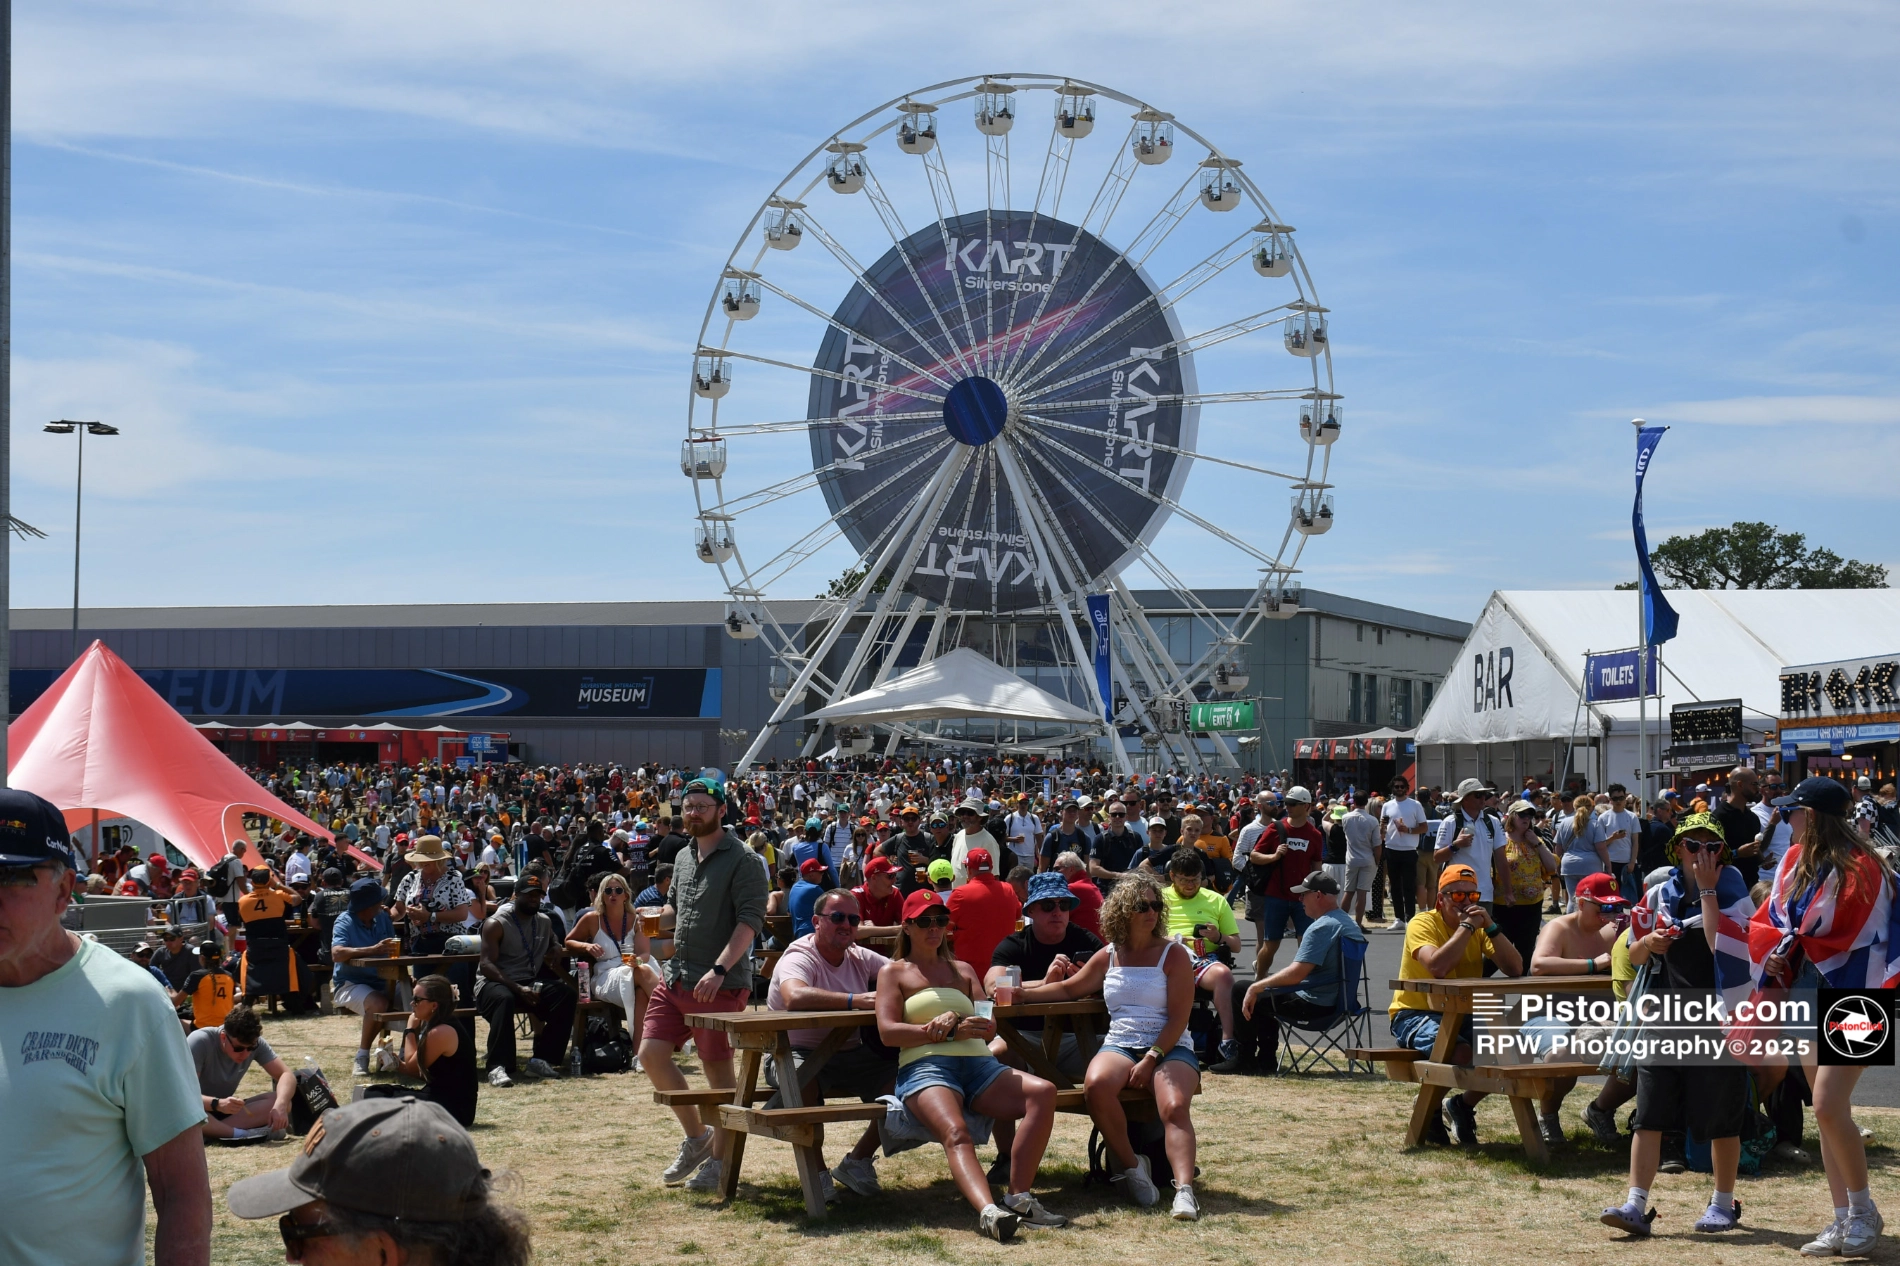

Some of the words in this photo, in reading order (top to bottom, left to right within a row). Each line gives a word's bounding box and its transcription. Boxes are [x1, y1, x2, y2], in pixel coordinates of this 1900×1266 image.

[945, 237, 1077, 277] KART
[965, 276, 1052, 292] Silverstone
[835, 332, 875, 470] KART
[1119, 347, 1163, 493] KART
[914, 542, 1045, 587] KART
[1473, 646, 1514, 713] BAR
[1601, 665, 1634, 687] TOILETS
[578, 689, 646, 702] MUSEUM
[1213, 715, 1226, 726] EXIT
[254, 899, 268, 912] 4
[217, 986, 227, 999] 4
[21, 1031, 67, 1055] CRABBY
[65, 1033, 99, 1066] DICK'S
[22, 1048, 50, 1066] BAR
[65, 1052, 88, 1077] GRILL
[305, 1084, 323, 1100] M&S
